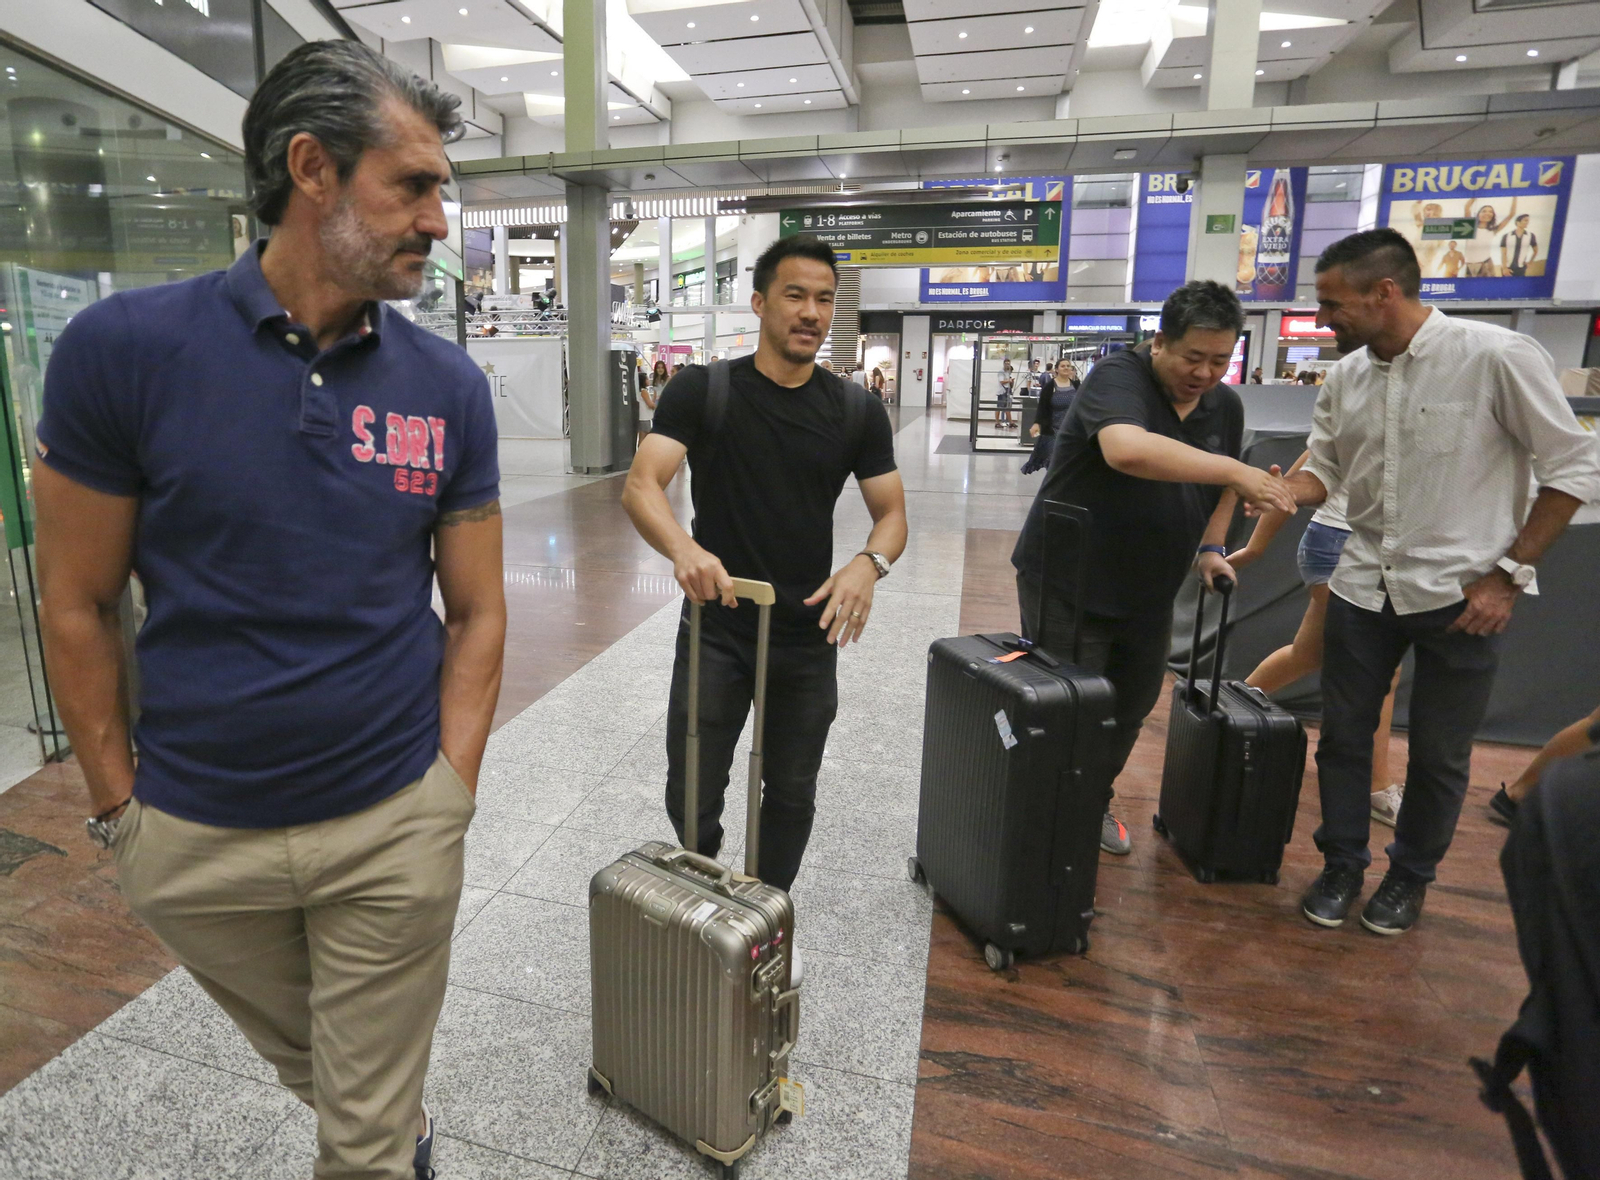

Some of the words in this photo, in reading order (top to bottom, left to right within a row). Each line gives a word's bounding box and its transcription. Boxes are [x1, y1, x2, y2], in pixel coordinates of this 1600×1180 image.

[1392, 163, 1531, 193] BRUGAL
[1185, 194, 1193, 203] ES
[951, 209, 1001, 219] Aparcamiento
[1024, 208, 1033, 221] P
[816, 214, 836, 227] 1-8
[847, 233, 872, 241] billetes
[891, 231, 912, 239] Metro
[938, 230, 968, 239] Estación
[969, 230, 979, 238] de
[980, 229, 1018, 238] autobuses
[1263, 242, 1287, 250] VIEJO
[962, 287, 969, 295] ES
[938, 319, 996, 329] PARFOIS
[618, 350, 630, 405] renfe
[351, 404, 446, 472] S.DRY
[394, 467, 438, 496] 523
